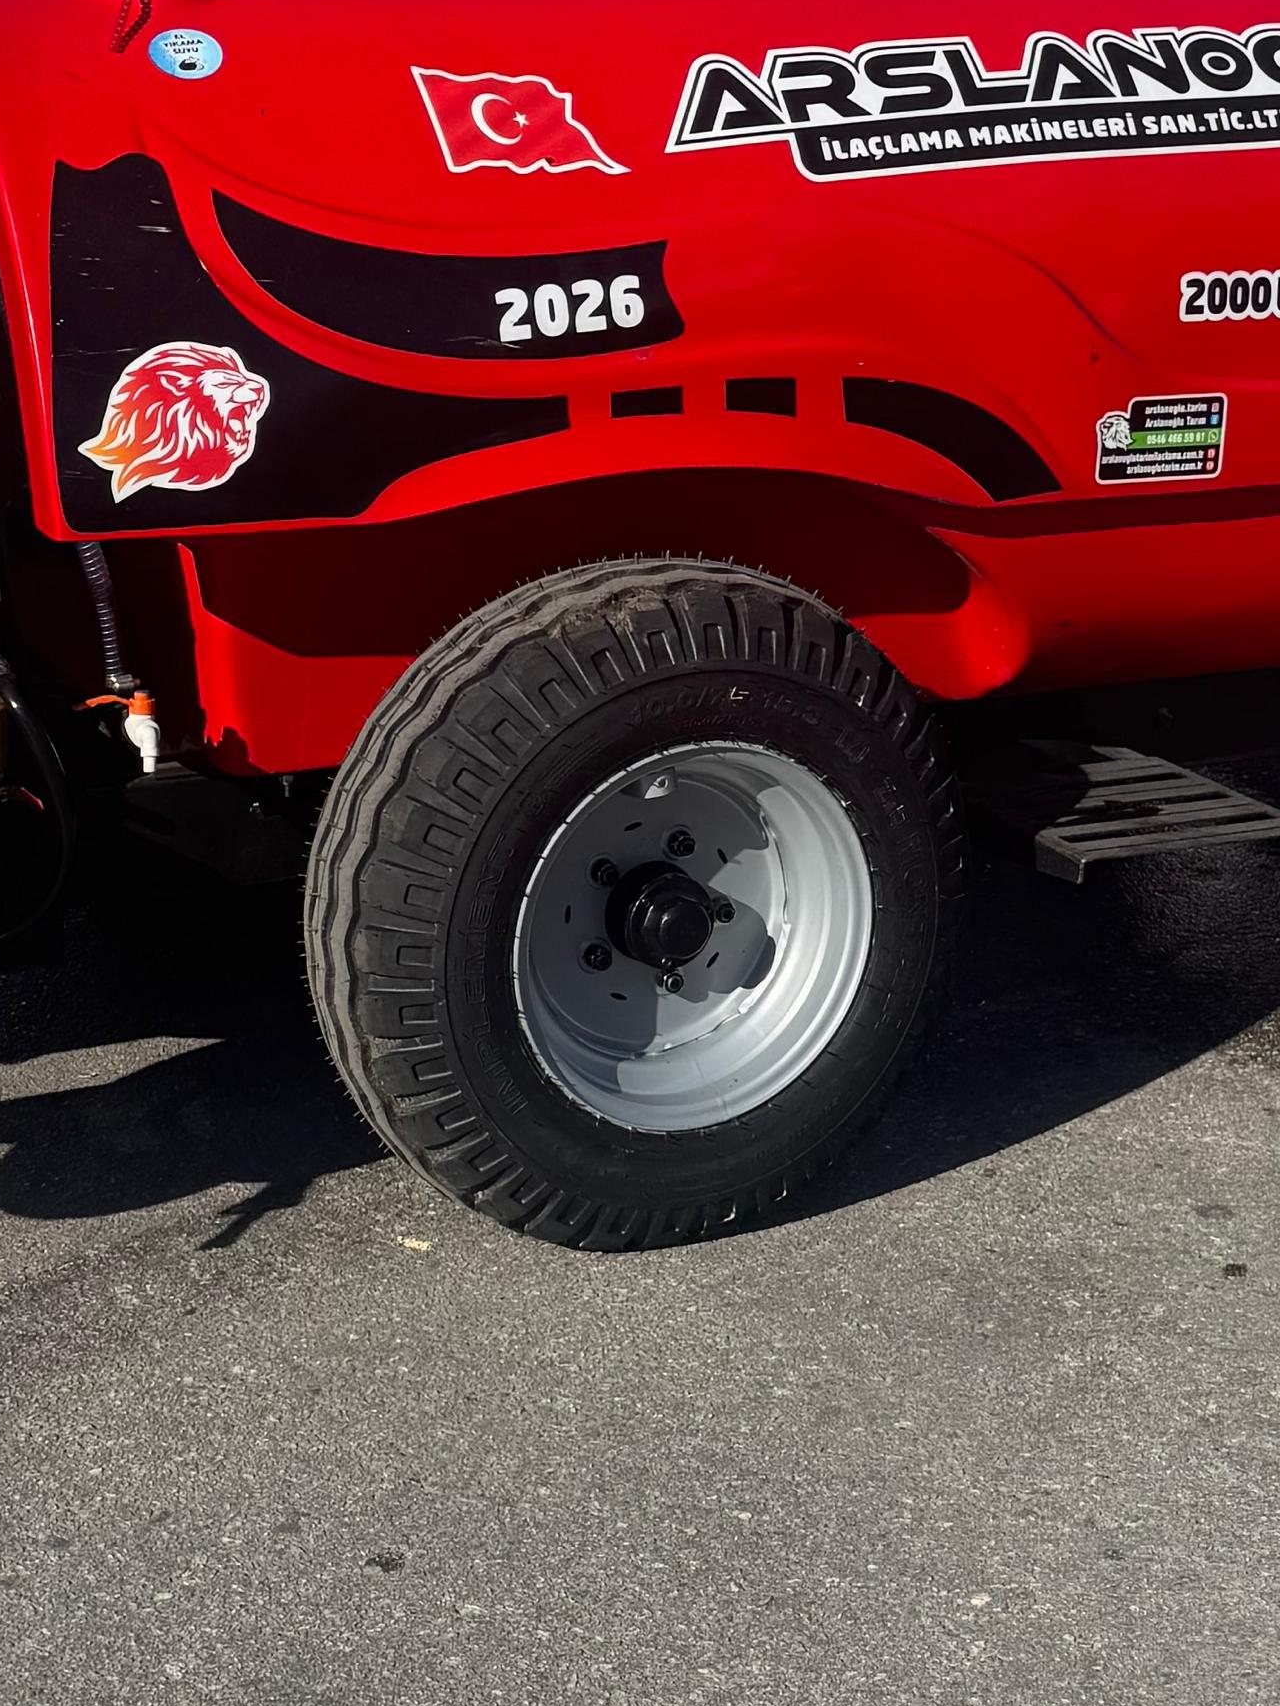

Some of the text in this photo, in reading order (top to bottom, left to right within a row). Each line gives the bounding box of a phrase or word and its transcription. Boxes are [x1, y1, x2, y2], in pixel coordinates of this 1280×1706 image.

[820, 127, 965, 162] İLAÇLAMA
[969, 111, 1138, 146] MAKİNELERİ
[494, 274, 645, 342] 2026
